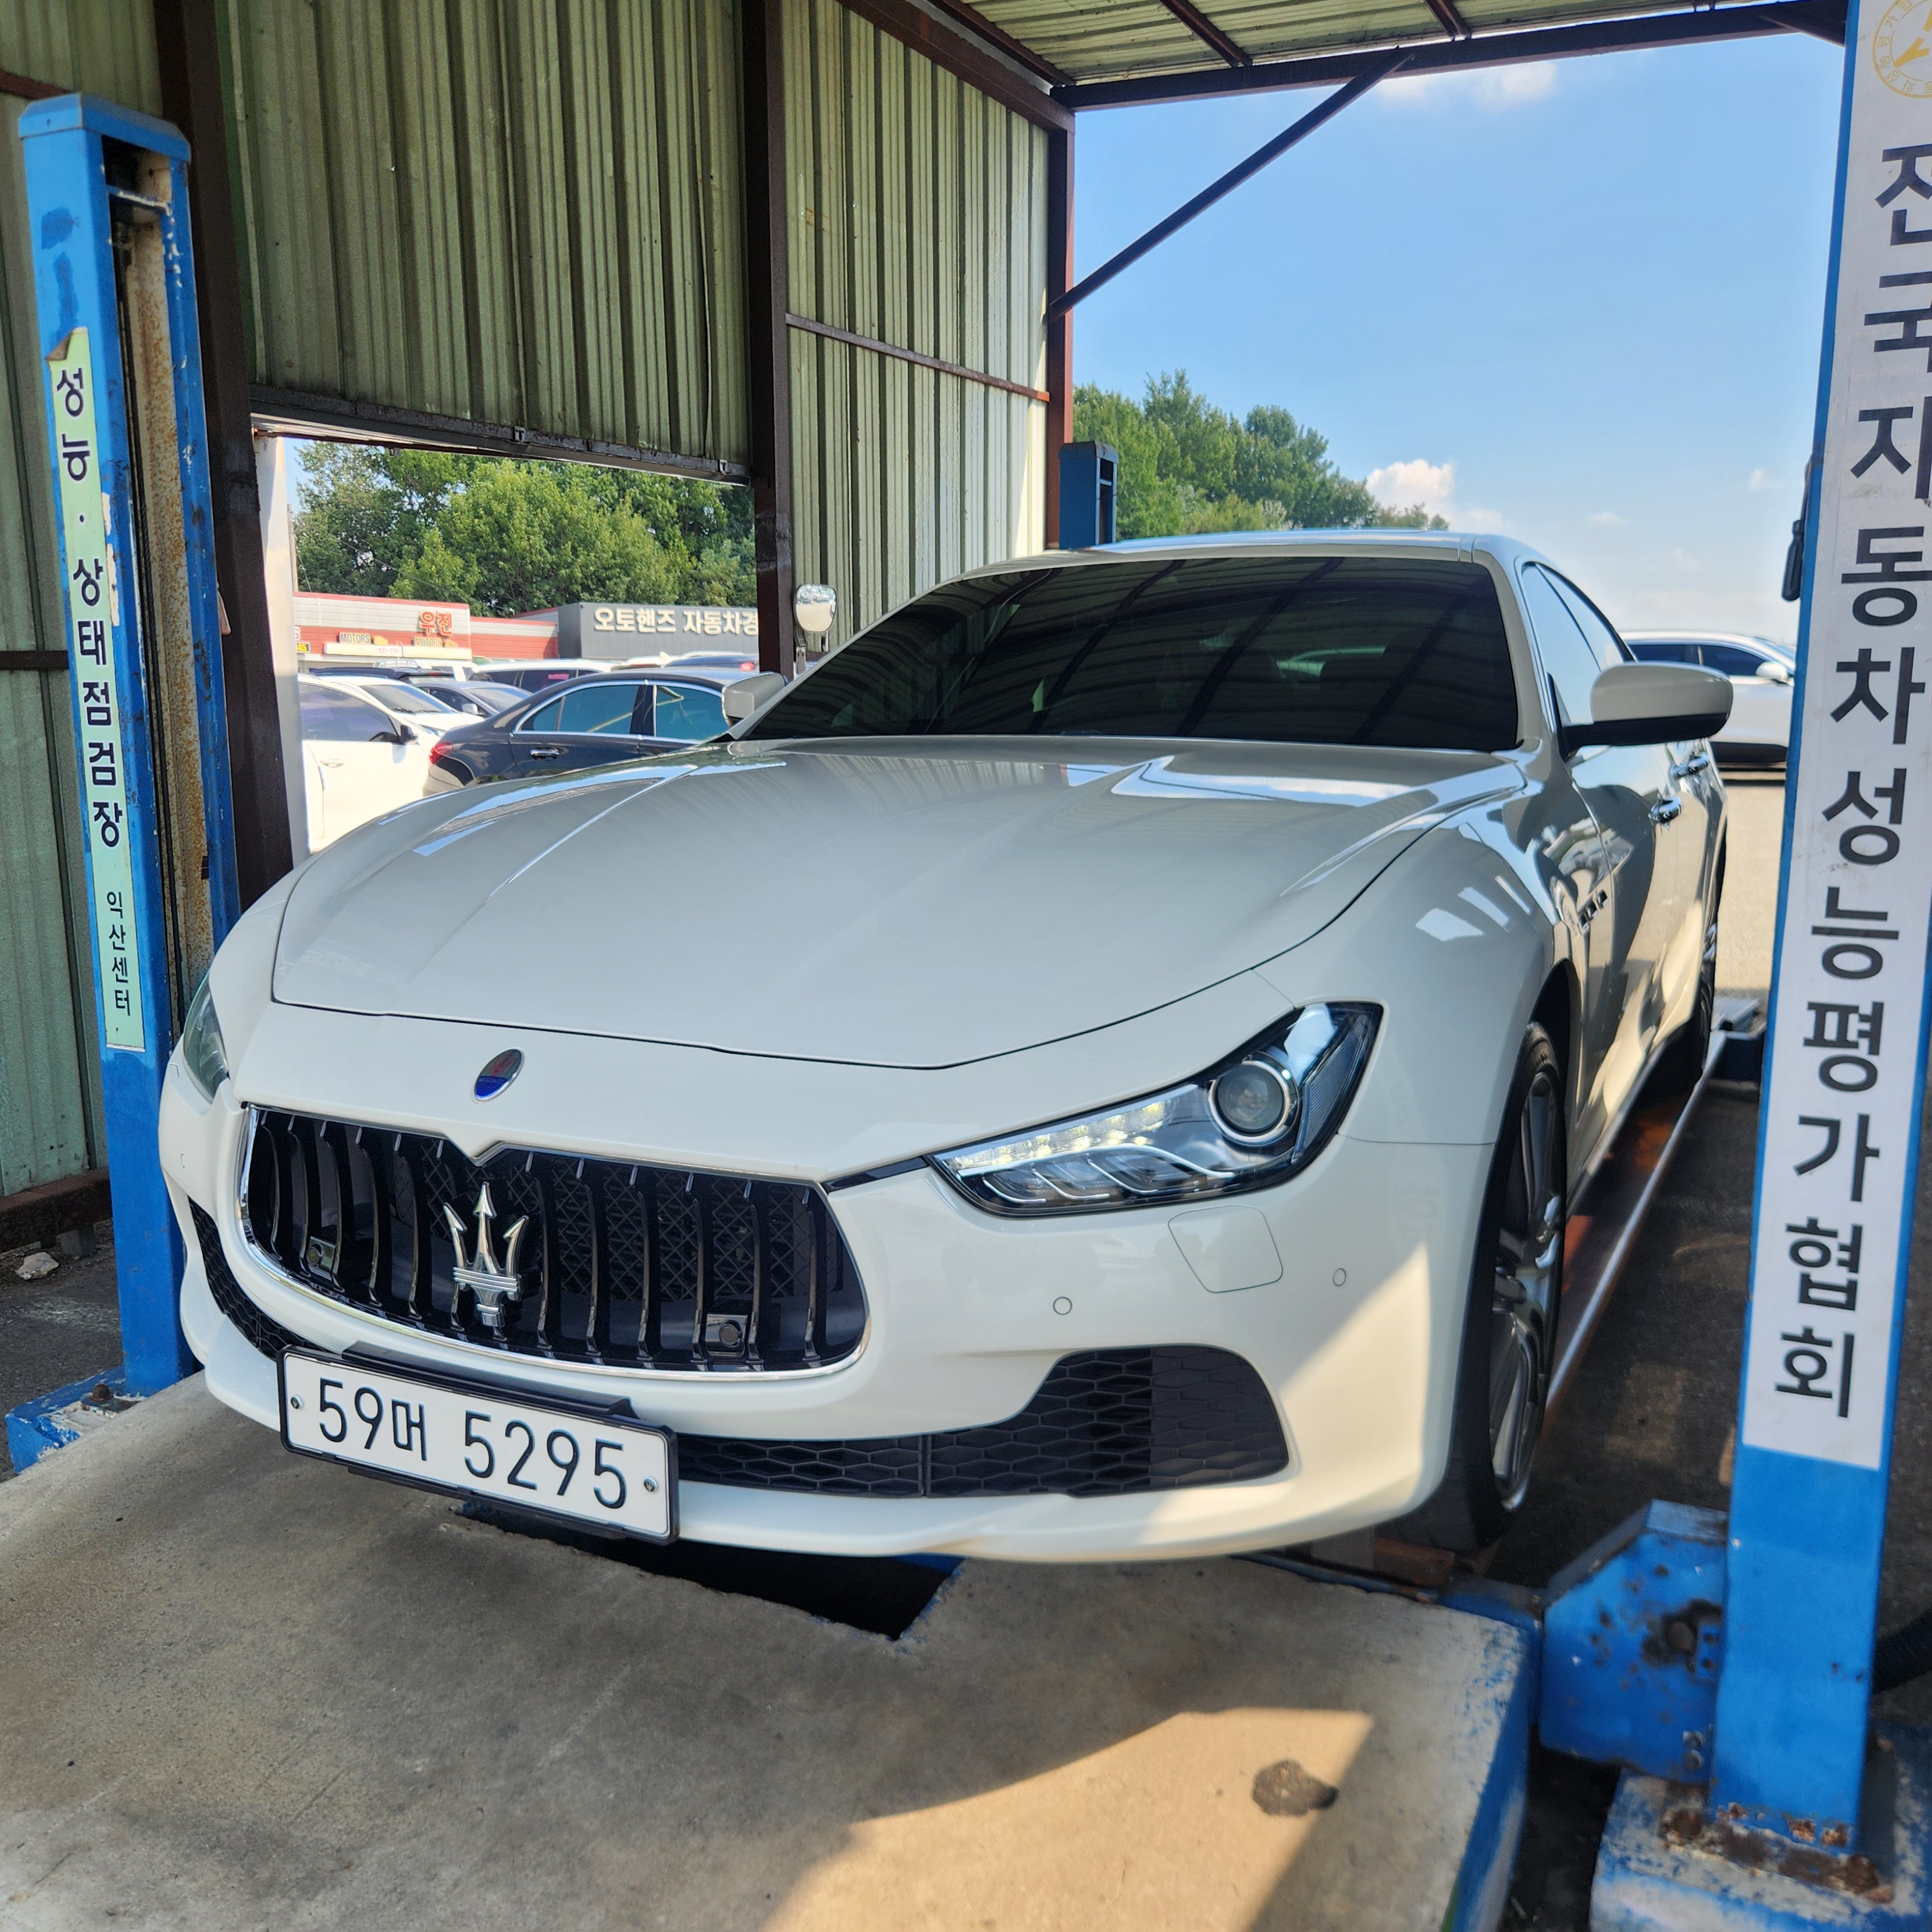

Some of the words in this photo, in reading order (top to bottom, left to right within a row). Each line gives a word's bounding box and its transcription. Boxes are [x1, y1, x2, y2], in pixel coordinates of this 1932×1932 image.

[593, 608, 677, 633] 오토핸즈
[340, 633, 371, 643] MOTORS
[415, 637, 443, 647] MOTORS
[106, 890, 131, 1016] 익산센터
[319, 1377, 427, 1461] 59머
[464, 1410, 627, 1509] 5295
